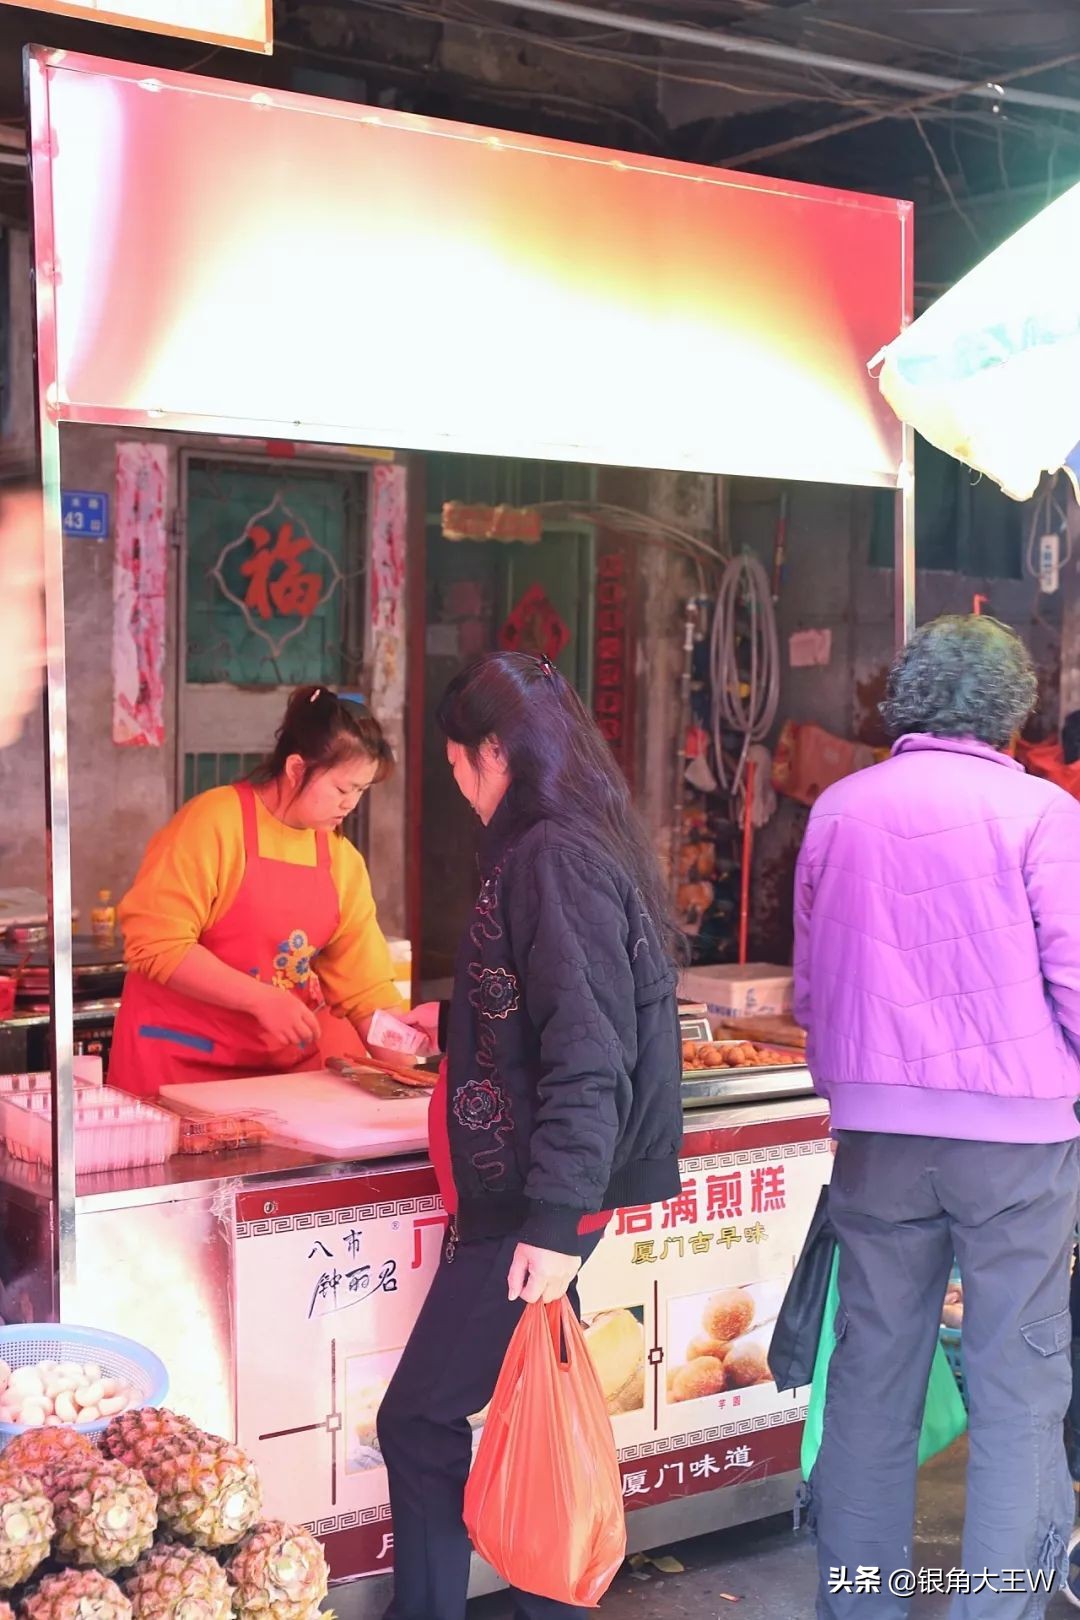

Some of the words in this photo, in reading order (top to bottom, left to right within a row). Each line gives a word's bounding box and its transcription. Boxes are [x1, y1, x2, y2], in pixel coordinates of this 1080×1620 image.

[240, 522, 323, 621] 福
[308, 1229, 363, 1259] 八市
[631, 1221, 769, 1265] 厦门古早味
[622, 1445, 755, 1497] 厦门味道
